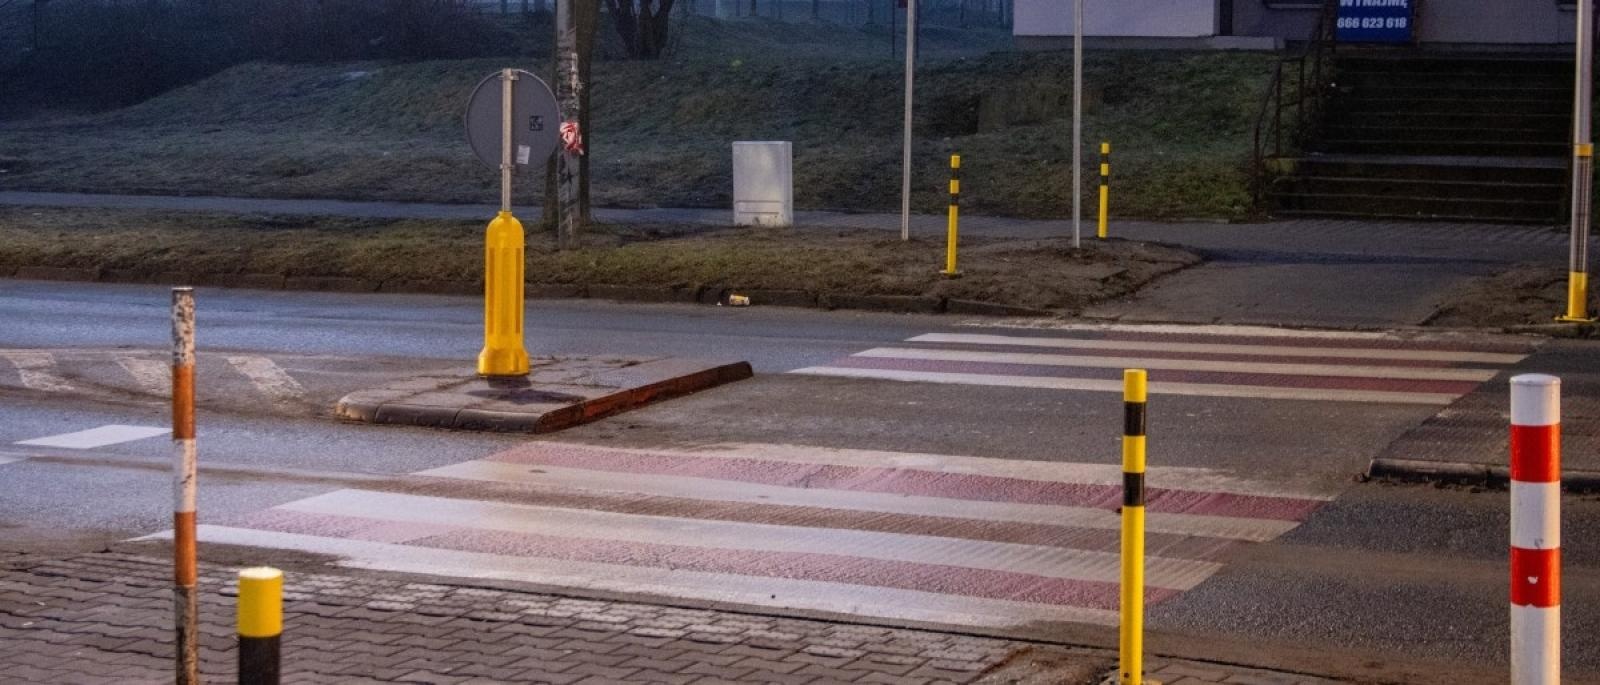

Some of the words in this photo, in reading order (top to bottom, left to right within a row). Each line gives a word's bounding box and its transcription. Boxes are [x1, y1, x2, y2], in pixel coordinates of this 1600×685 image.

[1337, 17, 1359, 28] 666
[1362, 17, 1384, 28] 623
[1386, 17, 1407, 28] 618
